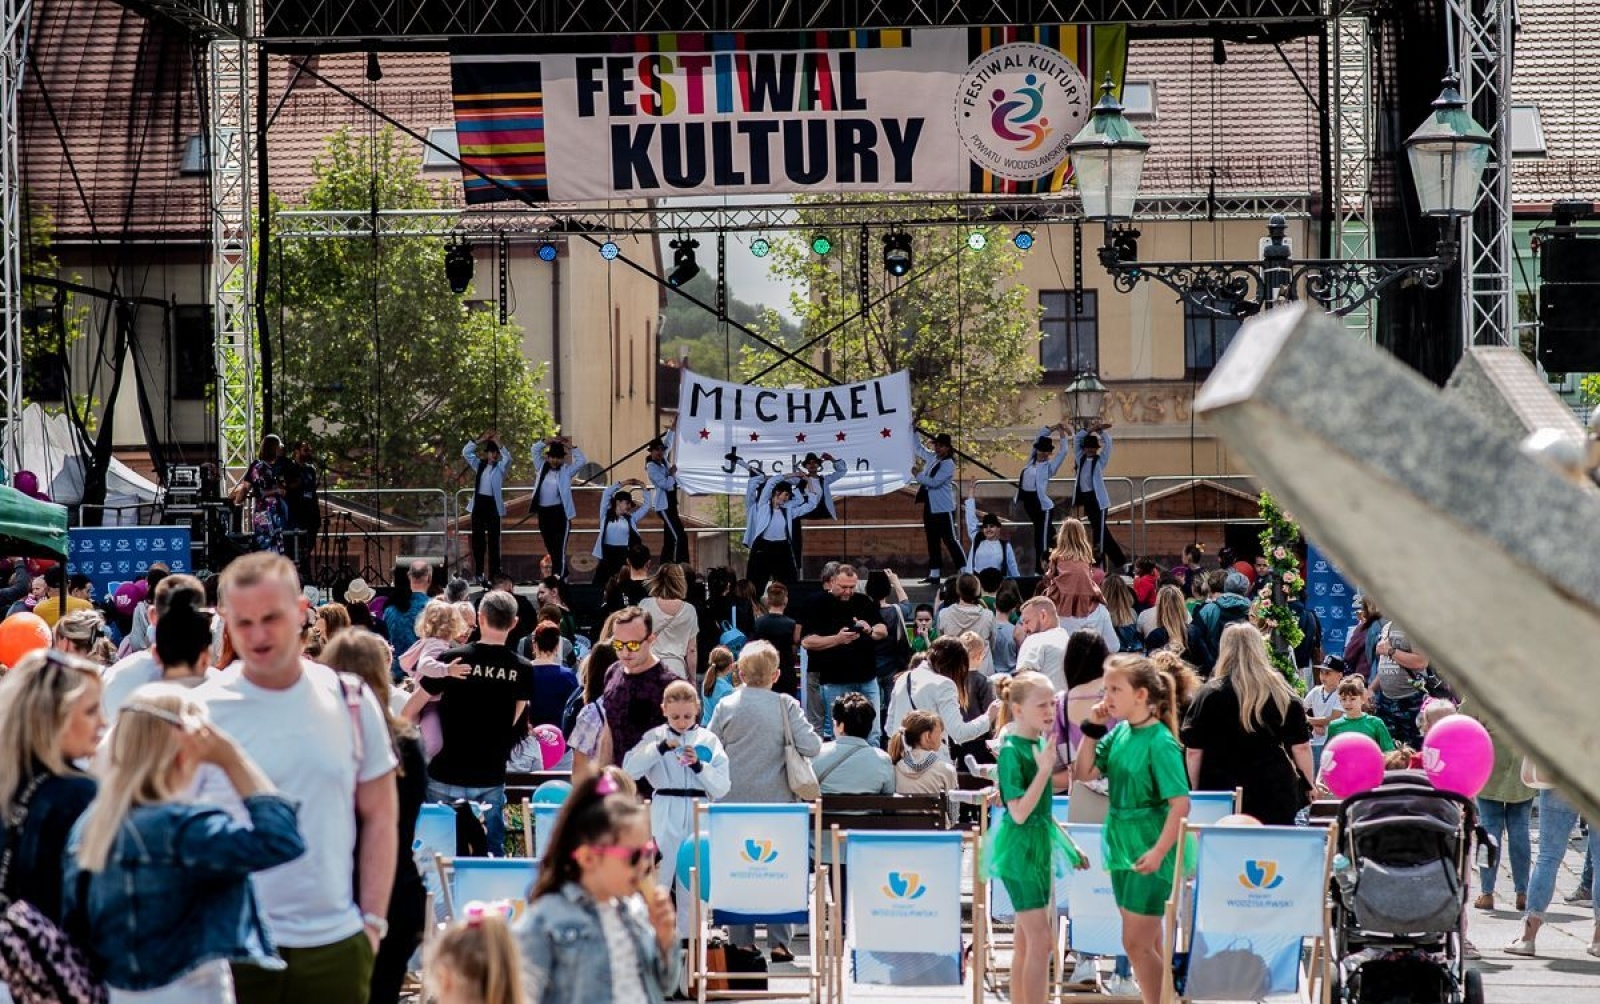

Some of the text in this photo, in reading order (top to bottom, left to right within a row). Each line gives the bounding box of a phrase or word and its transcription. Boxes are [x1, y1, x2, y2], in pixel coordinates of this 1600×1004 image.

[575, 52, 868, 118] FESTIWAL
[963, 54, 1081, 107] FESTIWAL KULTURY
[610, 117, 926, 191] KULTURY
[970, 133, 1001, 164] POWIATU
[689, 381, 897, 424] MICHAEL
[721, 446, 870, 474] Jackn
[472, 664, 518, 681] AKAR
